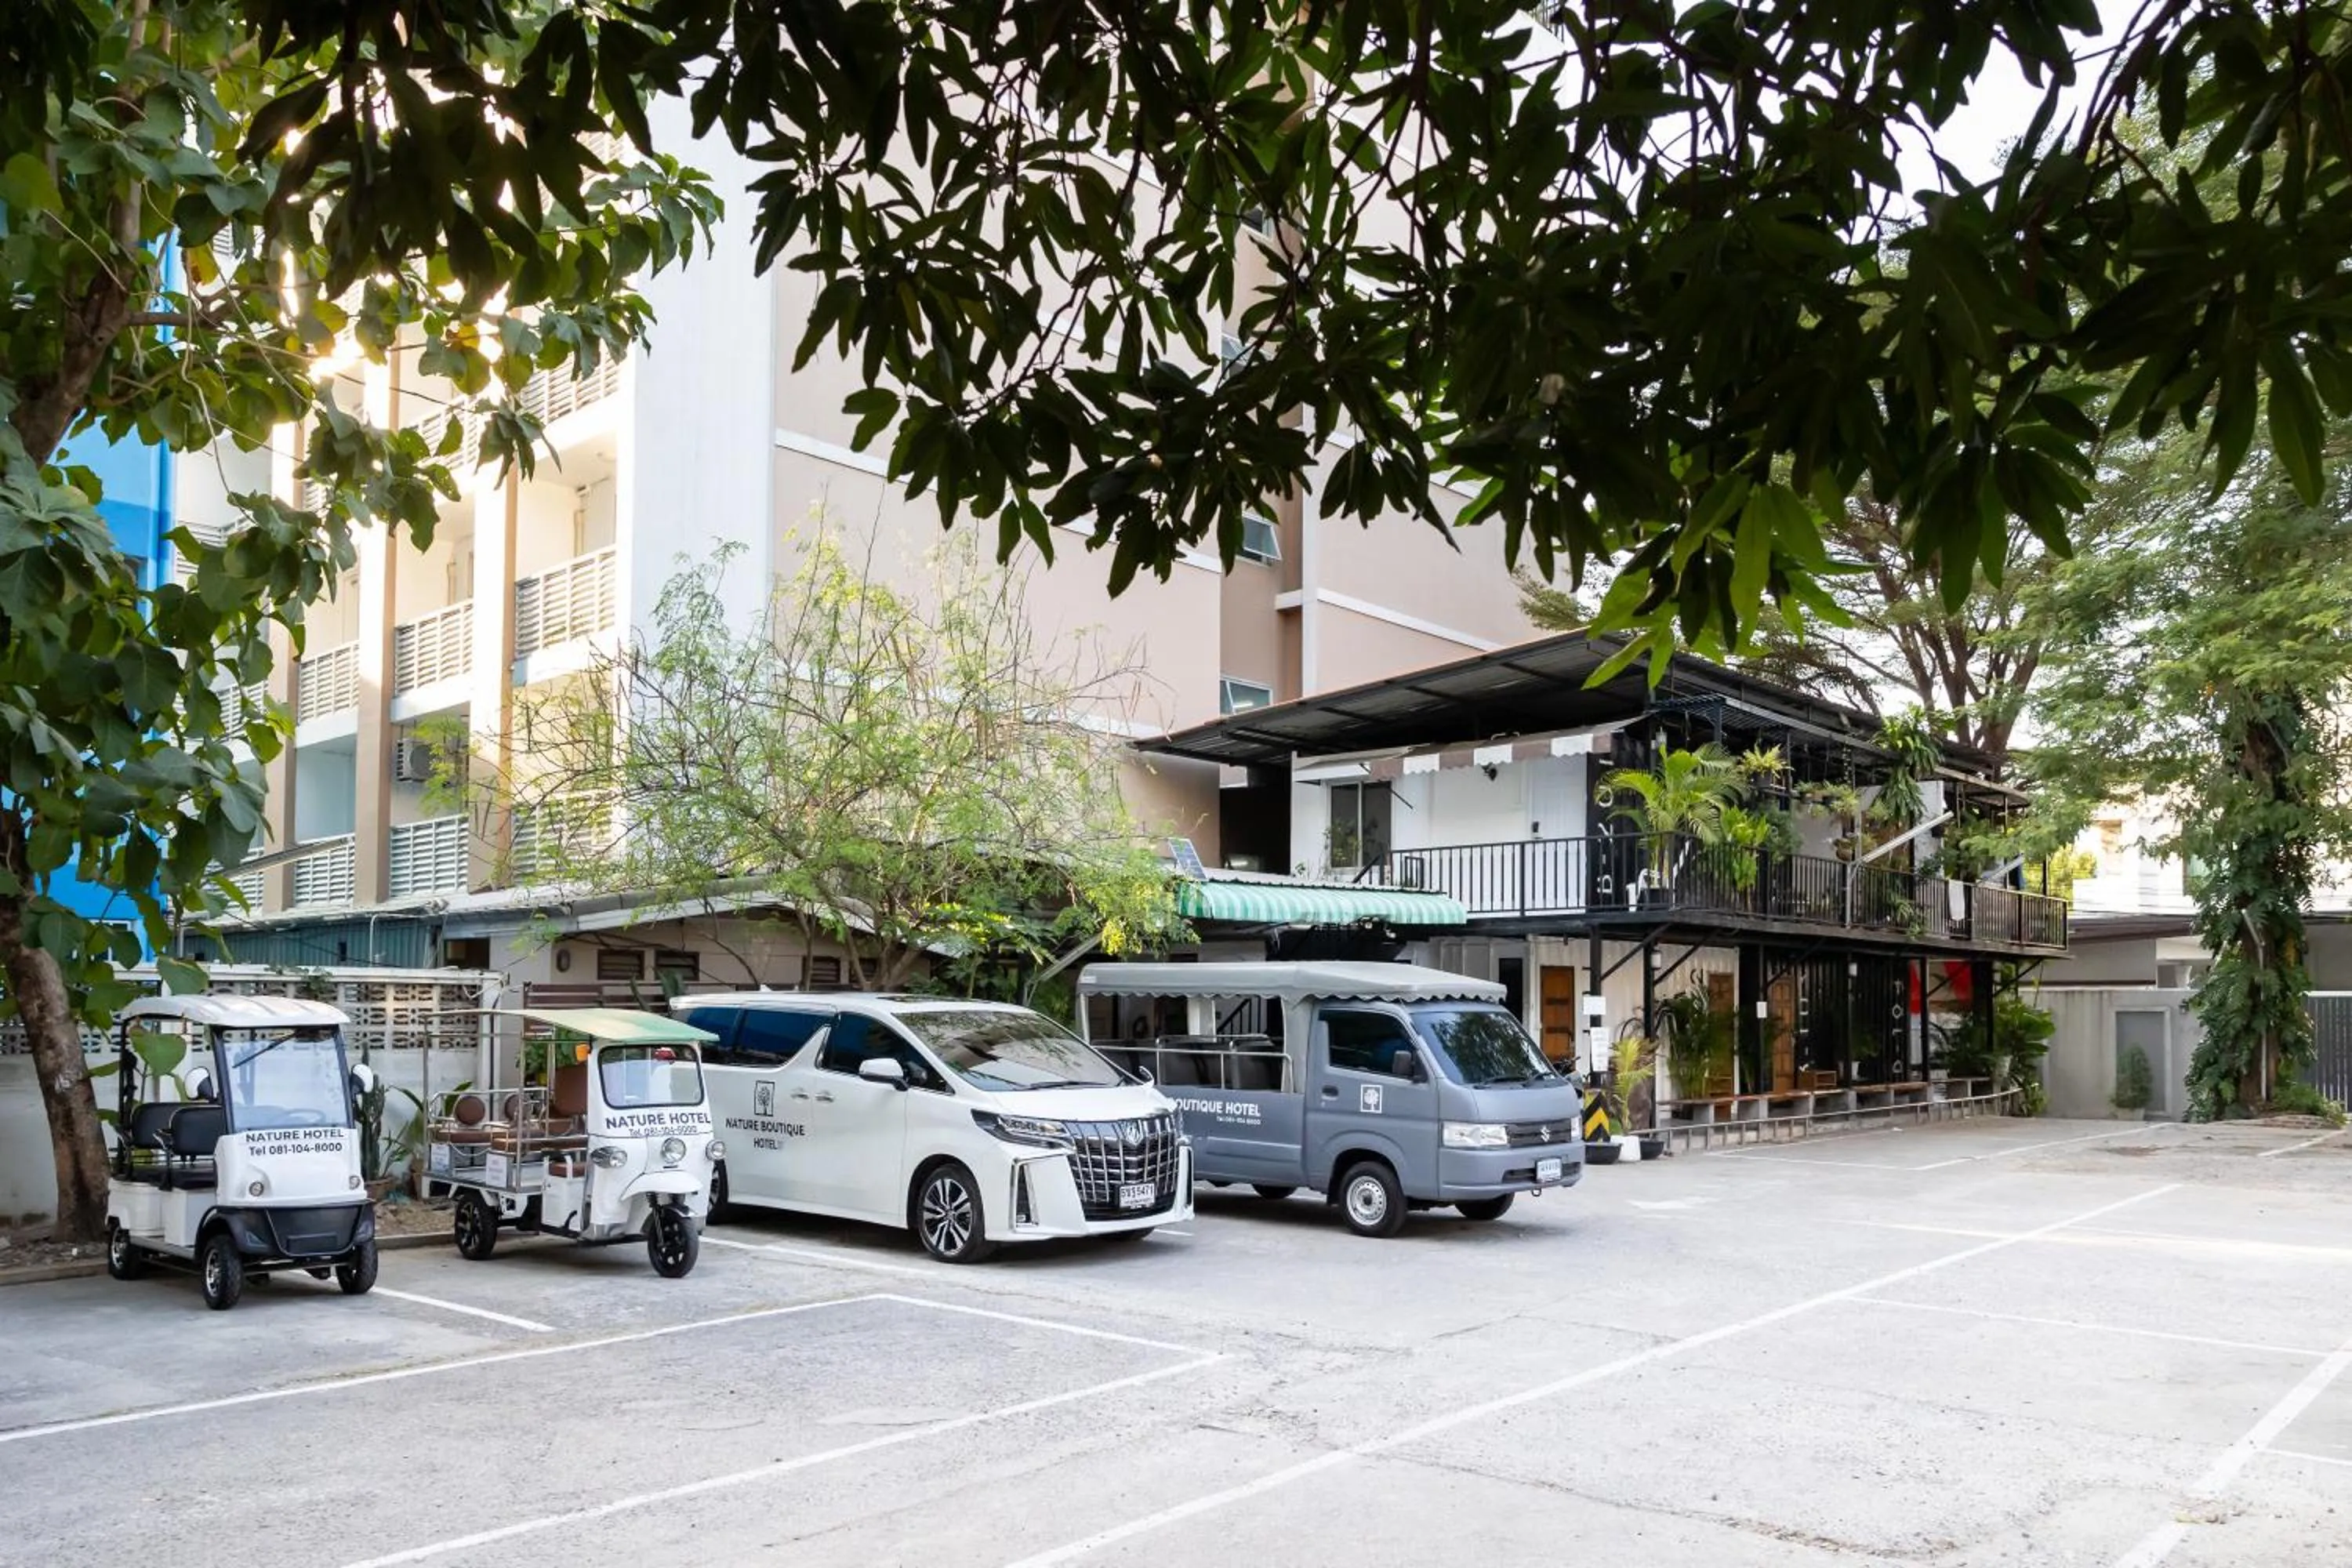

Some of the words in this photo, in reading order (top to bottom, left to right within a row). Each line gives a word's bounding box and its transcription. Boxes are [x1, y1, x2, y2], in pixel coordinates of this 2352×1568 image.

[1175, 1098, 1223, 1113] OUTIQUE
[1225, 1102, 1261, 1116] HOTEL
[605, 1113, 666, 1129] NATURE
[669, 1112, 710, 1124] HOTEL
[725, 1118, 759, 1131] NATURE
[760, 1120, 805, 1137] BOUTIQUE
[245, 1130, 299, 1142] NATURE
[303, 1129, 344, 1139] HOTEL
[249, 1145, 266, 1156] Tel
[269, 1142, 343, 1155] 081-104-8000
[753, 1138, 778, 1149] HOTEL
